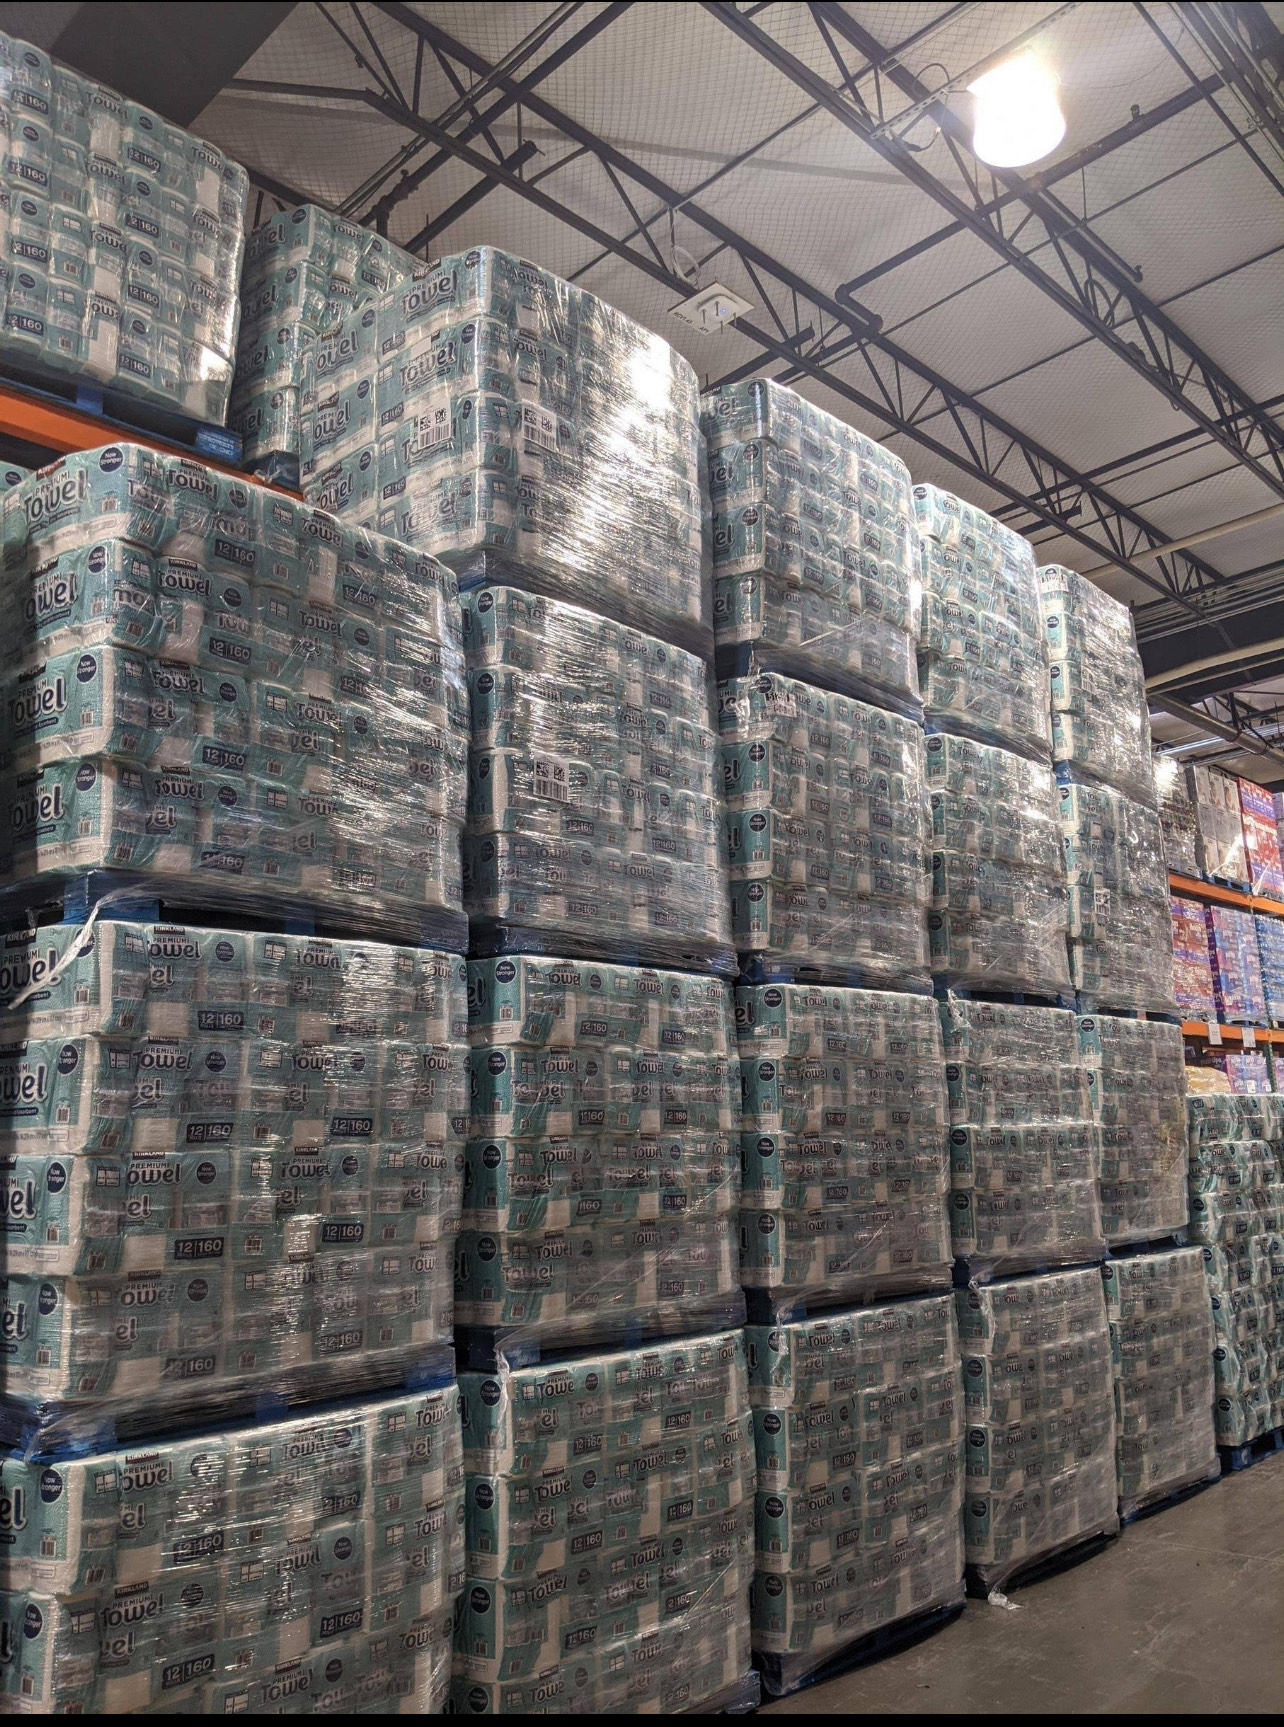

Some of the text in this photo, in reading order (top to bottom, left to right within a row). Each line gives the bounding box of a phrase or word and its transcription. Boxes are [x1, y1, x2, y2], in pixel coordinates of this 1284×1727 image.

[402, 270, 457, 314] Towel
[167, 470, 218, 501] Towel
[24, 470, 87, 523] Towel
[301, 518, 343, 548] Towel
[218, 542, 254, 563] 12 160
[158, 572, 212, 598] Towel
[213, 640, 250, 660] 12 160
[206, 749, 245, 766] 12 160
[0, 950, 61, 990] owel
[634, 978, 664, 996] Towel
[200, 1012, 242, 1025] 12 160
[132, 1050, 192, 1071] Towel
[541, 1060, 580, 1075] Towel
[0, 1064, 46, 1101] wel
[190, 1124, 232, 1136] 12 160
[334, 1119, 370, 1131] 12 160
[540, 1149, 578, 1165] Towel
[128, 1164, 182, 1185] owel
[282, 1162, 331, 1179] Towel
[326, 1224, 362, 1236] 12 160
[178, 1240, 222, 1252] 12 160
[534, 1243, 573, 1260] Towel
[189, 1358, 214, 1373] 160
[576, 1440, 584, 1450] 12
[124, 1463, 162, 1475] PREMIUM
[574, 1533, 602, 1547] 12 160
[630, 1544, 665, 1568] Towel
[101, 1594, 164, 1627] Towel
[112, 1596, 150, 1608] PREMIUM
[322, 1612, 360, 1630] 12 160
[166, 1658, 212, 1681] 12 160
[260, 1668, 313, 1703] Towel
